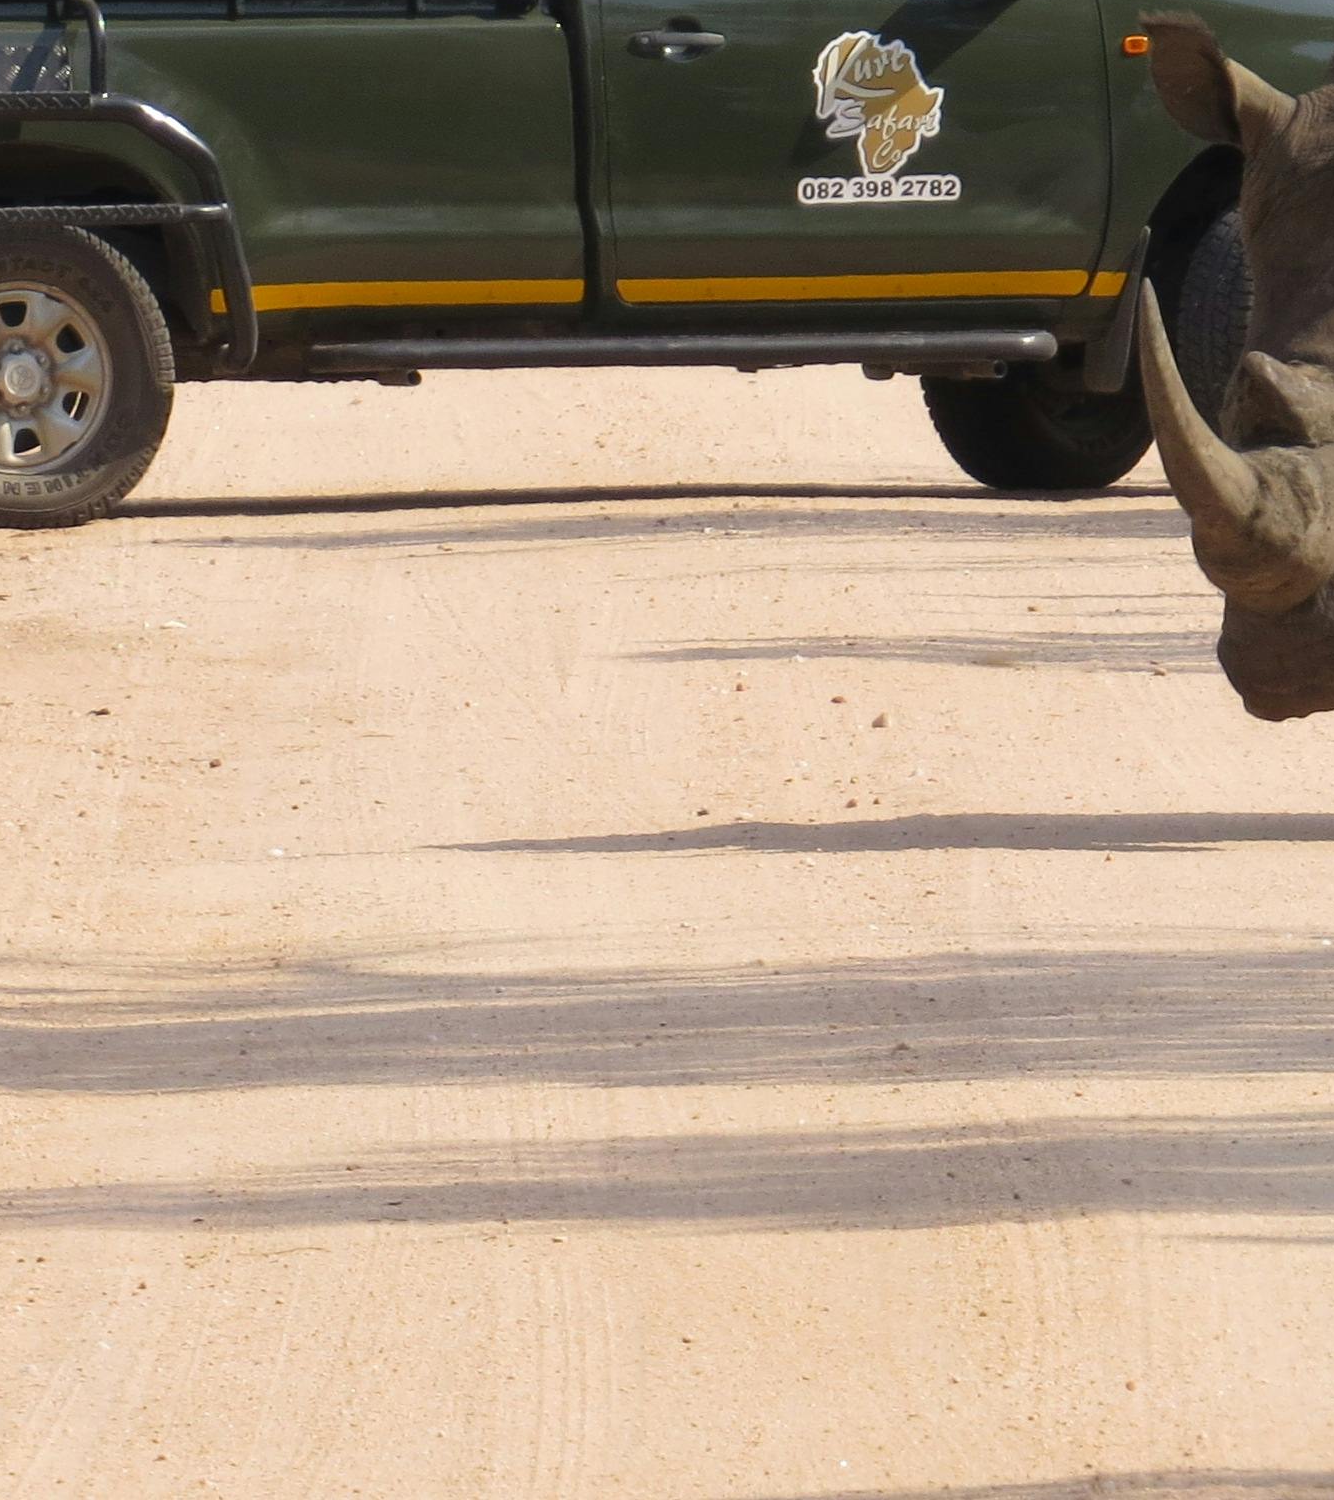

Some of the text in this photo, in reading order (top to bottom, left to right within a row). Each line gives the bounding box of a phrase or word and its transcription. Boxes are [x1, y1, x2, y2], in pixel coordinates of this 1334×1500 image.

[820, 36, 904, 112] Kurt
[828, 102, 939, 137] Safari
[872, 139, 900, 168] Co
[802, 180, 957, 200] 082 398 2782
